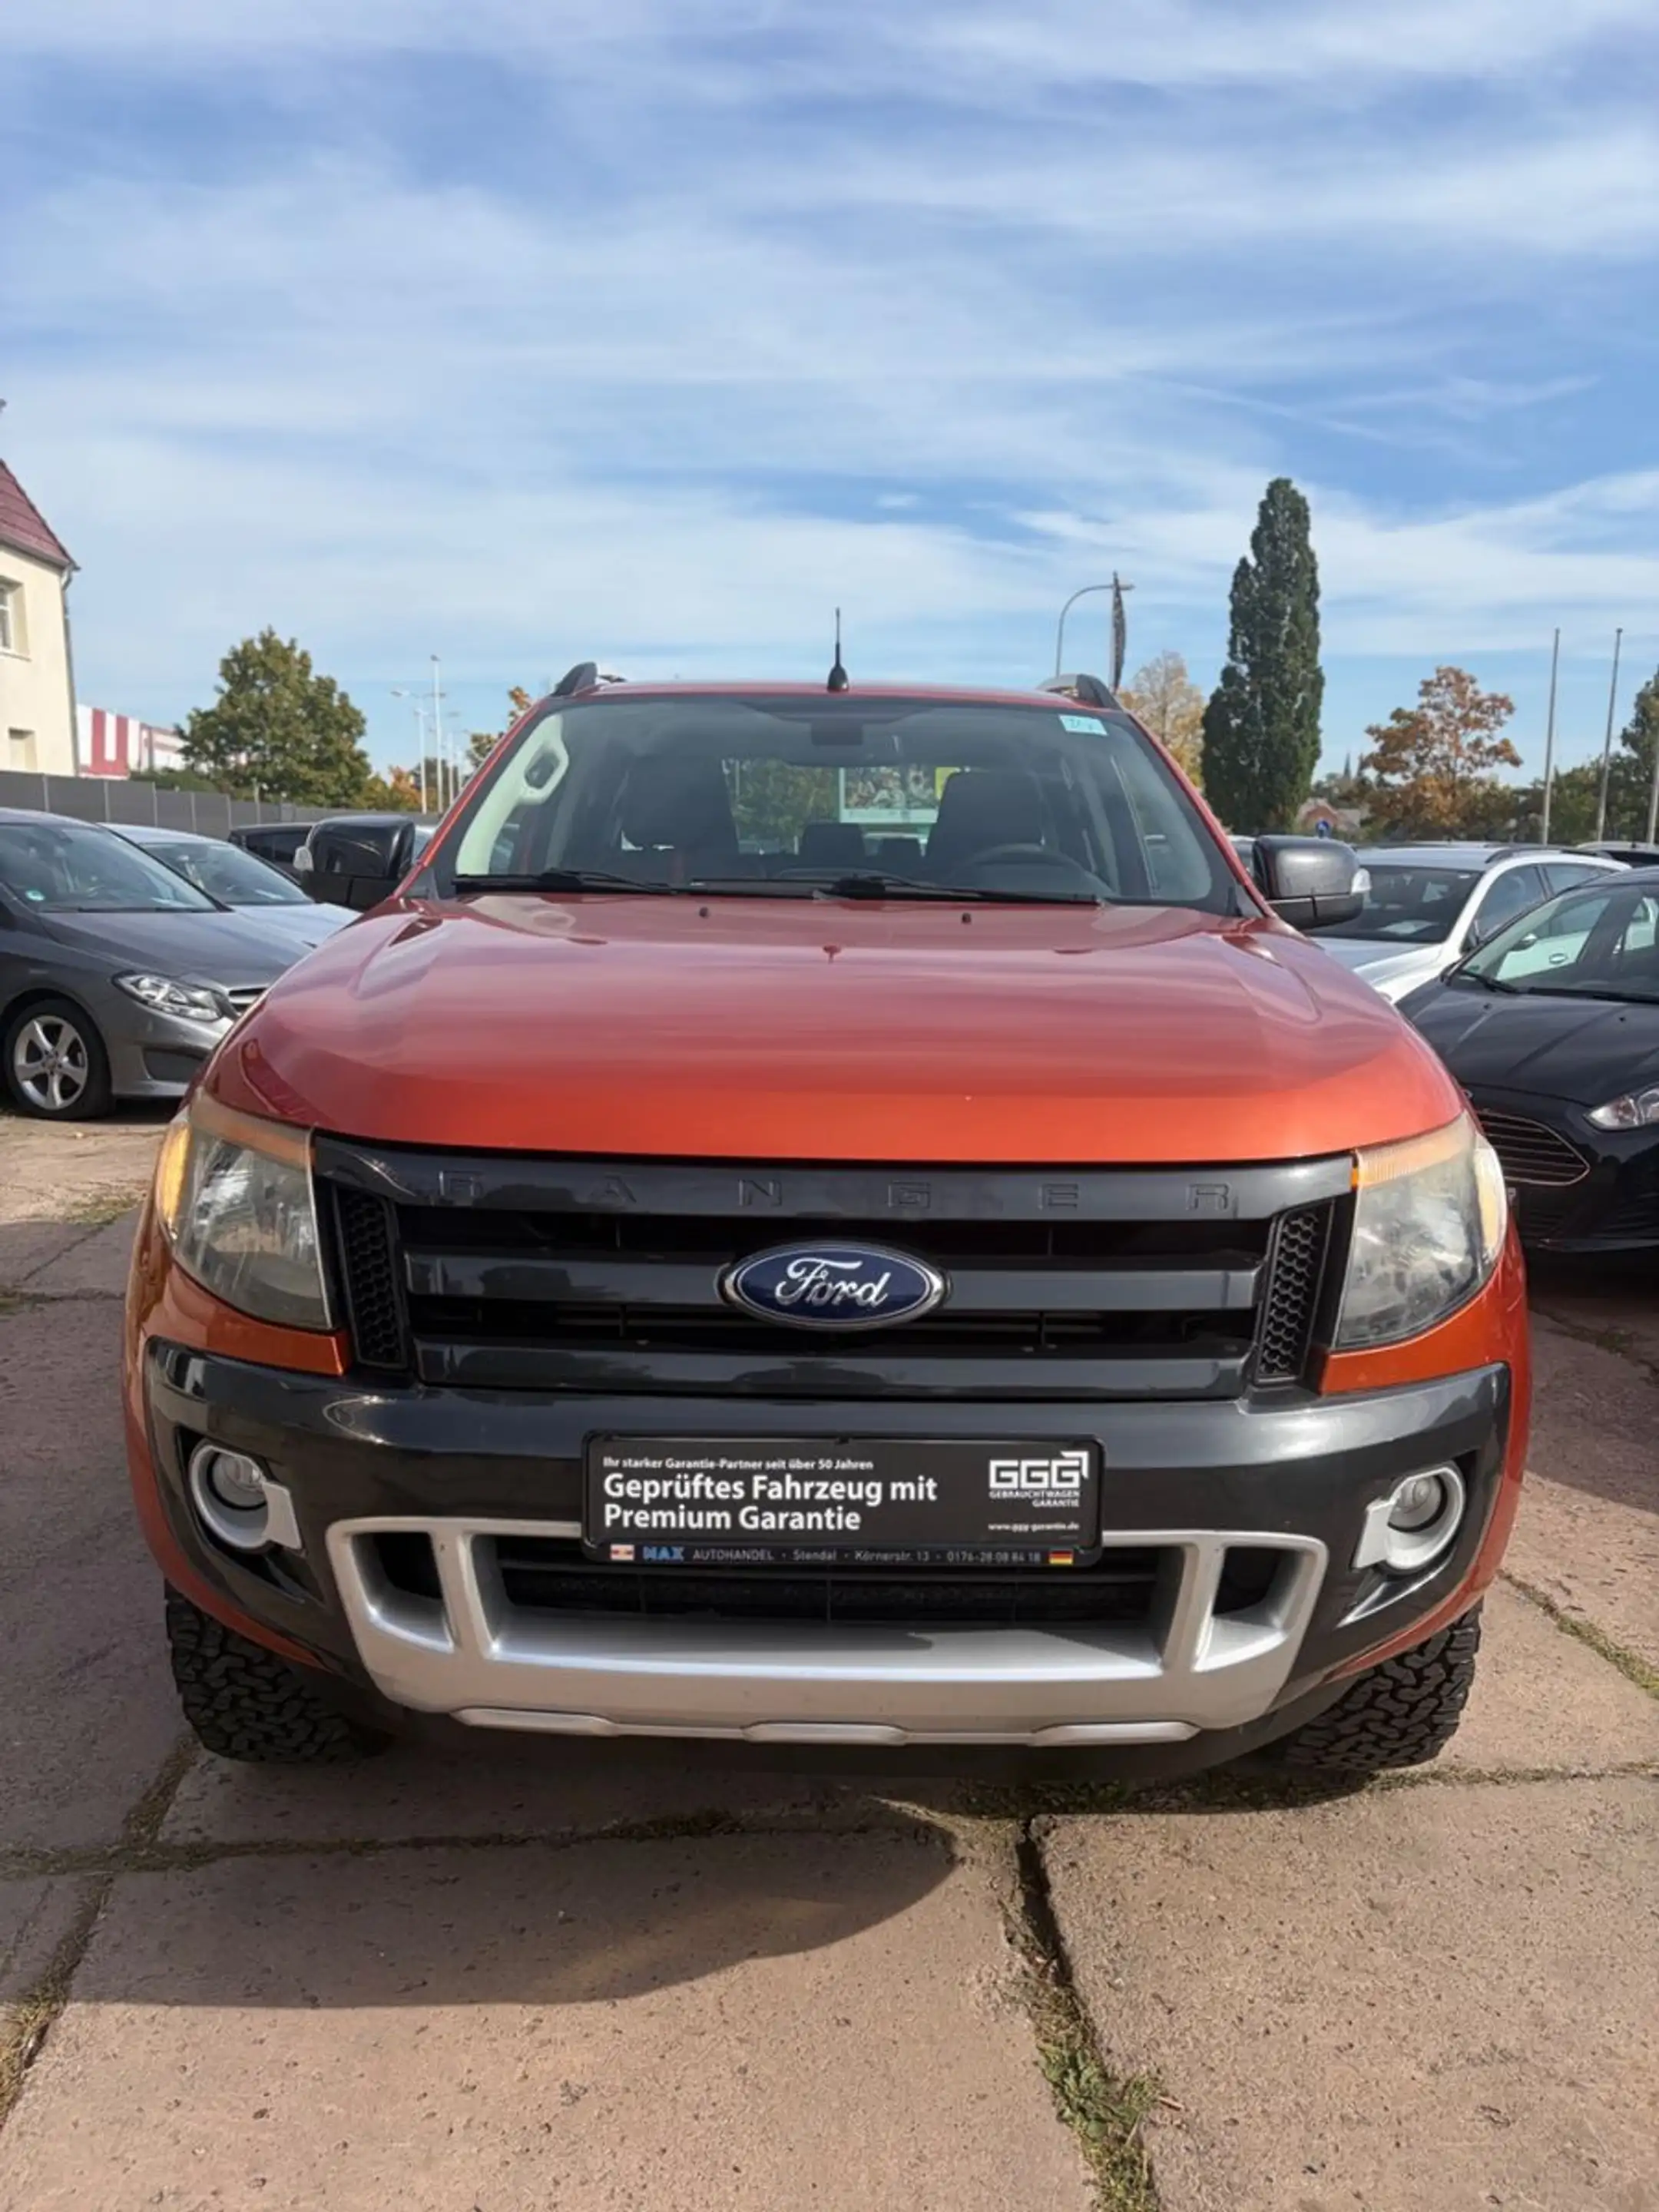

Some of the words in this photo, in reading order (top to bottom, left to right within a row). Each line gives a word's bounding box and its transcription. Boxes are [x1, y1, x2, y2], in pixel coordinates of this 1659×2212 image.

[439, 1169, 1237, 1211] RANGER
[775, 1257, 891, 1306] Ford
[603, 1457, 619, 1468] Ihr
[622, 1457, 662, 1469] starker
[665, 1457, 762, 1469] Garantie-Partner
[765, 1459, 786, 1470] seit
[789, 1459, 816, 1470] über
[818, 1459, 833, 1470] 50
[834, 1459, 874, 1470] Jahren
[989, 1459, 1081, 1488] GGG
[604, 1472, 745, 1505] Geprüftes
[753, 1473, 882, 1507] Fahrzeug
[889, 1475, 938, 1501] mit
[988, 1489, 1080, 1498] GEBRAUCHTWAGEN
[1032, 1498, 1080, 1508] GARANTIE
[604, 1503, 731, 1528] Premium
[738, 1505, 862, 1530] Garantie
[988, 1522, 1079, 1532] www.ggg-garantie.de
[694, 1548, 774, 1561] AUTOHANDEL
[793, 1548, 837, 1561] Stendal
